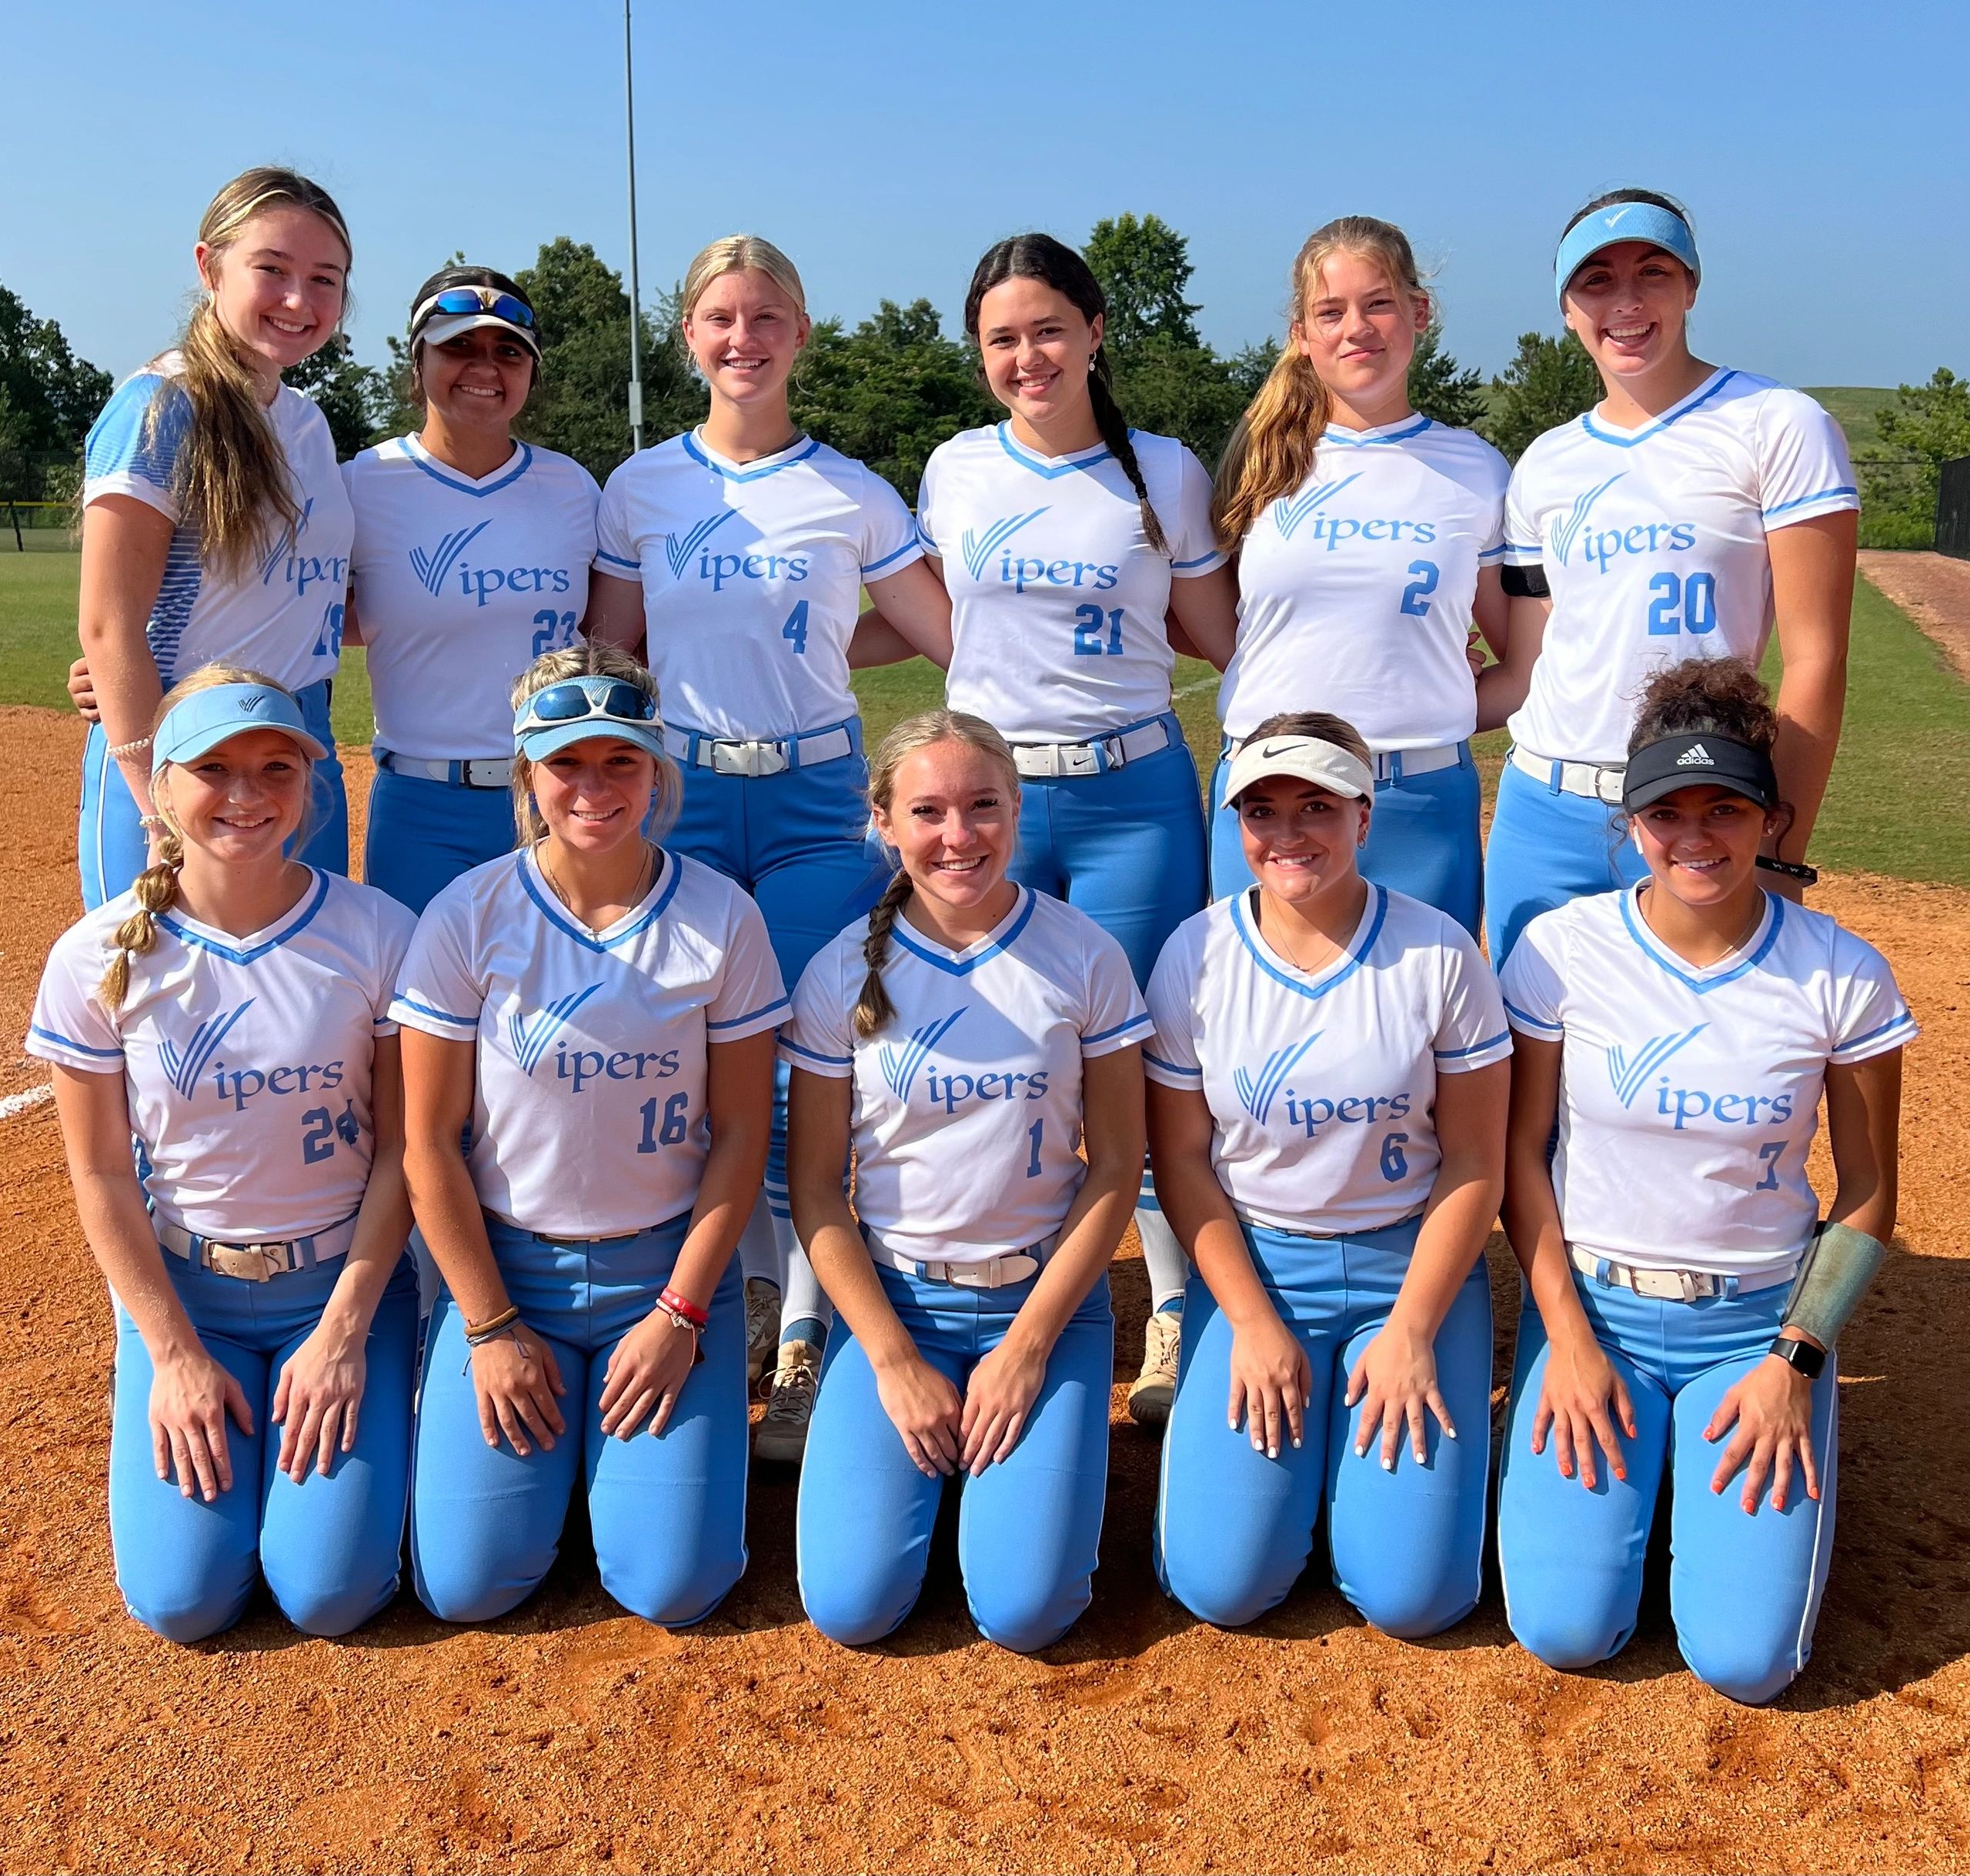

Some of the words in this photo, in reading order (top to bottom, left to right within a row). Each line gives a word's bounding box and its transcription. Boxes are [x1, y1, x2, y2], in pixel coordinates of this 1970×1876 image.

[1274, 470, 1437, 551] Vipers
[1551, 470, 1696, 575] Vipers
[409, 519, 570, 607] Vipers
[666, 505, 809, 593] Vipers
[962, 505, 1118, 593] Vipers
[1400, 559, 1440, 616] 2
[1648, 572, 1716, 636] 20
[782, 599, 809, 654] 4
[1073, 604, 1124, 656] 21
[1677, 757, 1715, 766] adidas
[157, 996, 344, 1112] Vipers
[507, 981, 680, 1094] Vipers
[879, 1006, 1049, 1113] Vipers
[1233, 1028, 1411, 1137] Vipers
[1606, 1022, 1793, 1130] Vipers
[302, 1099, 359, 1165] 24
[637, 1091, 689, 1153] 16
[1027, 1117, 1043, 1179] 1
[1379, 1133, 1409, 1183] 6
[1755, 1140, 1790, 1190] 7
